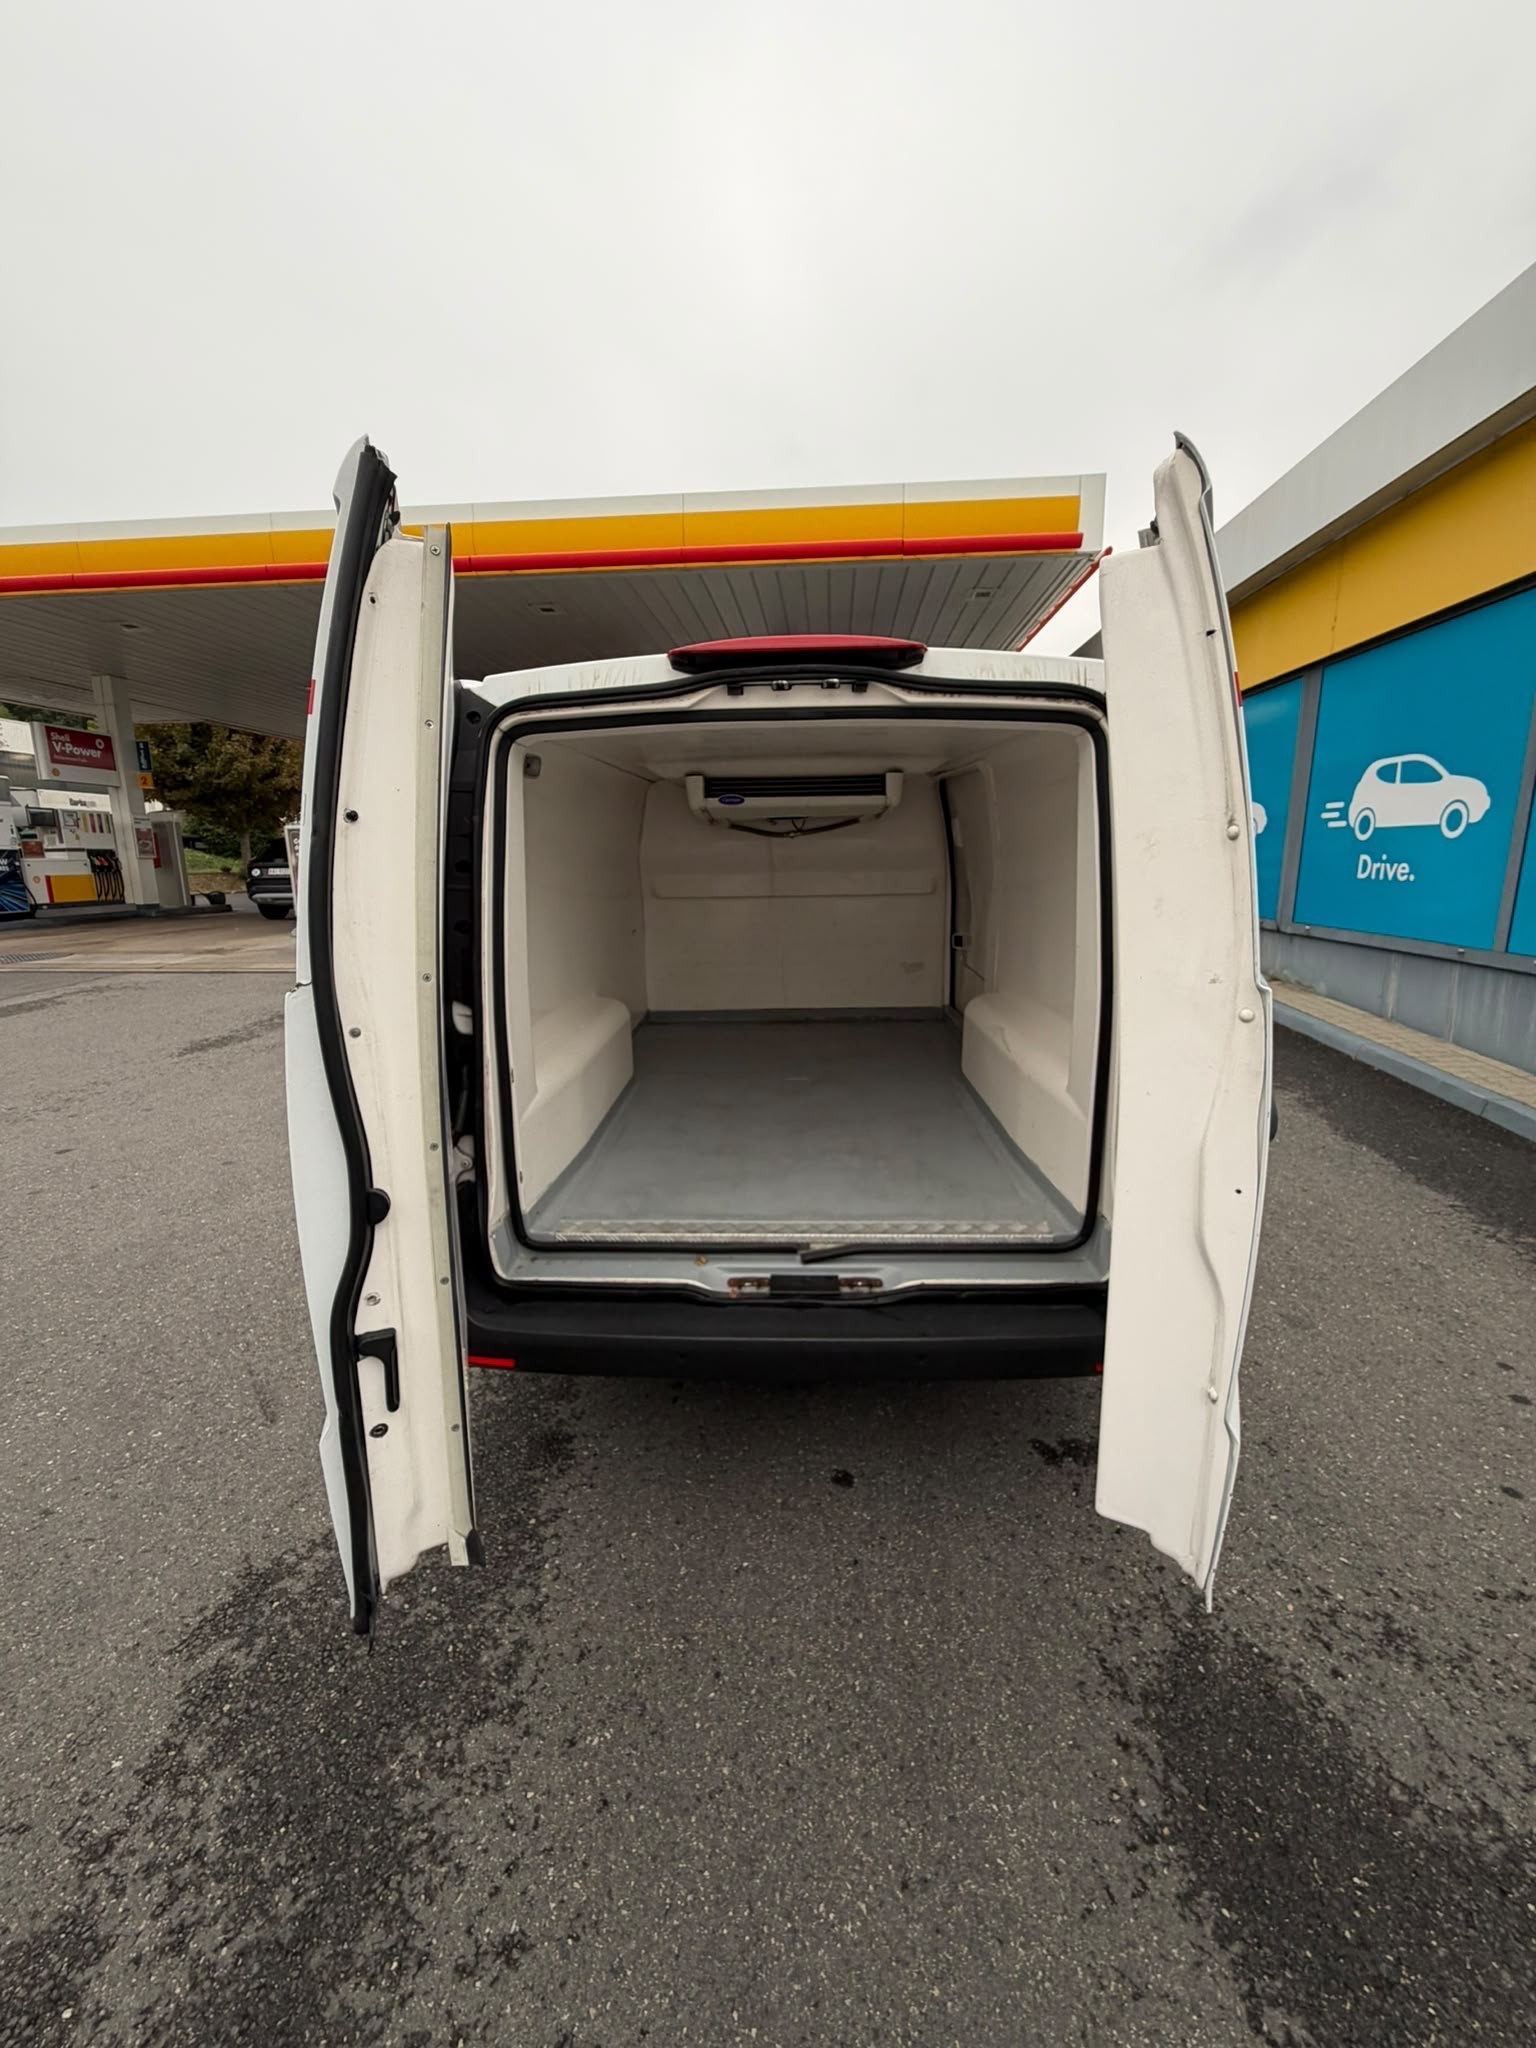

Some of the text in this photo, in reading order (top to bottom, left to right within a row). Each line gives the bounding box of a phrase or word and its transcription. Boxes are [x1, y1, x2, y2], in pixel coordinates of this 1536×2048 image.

[50, 732, 71, 742] Shell
[52, 741, 102, 759] V-Power
[140, 775, 148, 785] 2
[1356, 853, 1415, 882] Drive.
